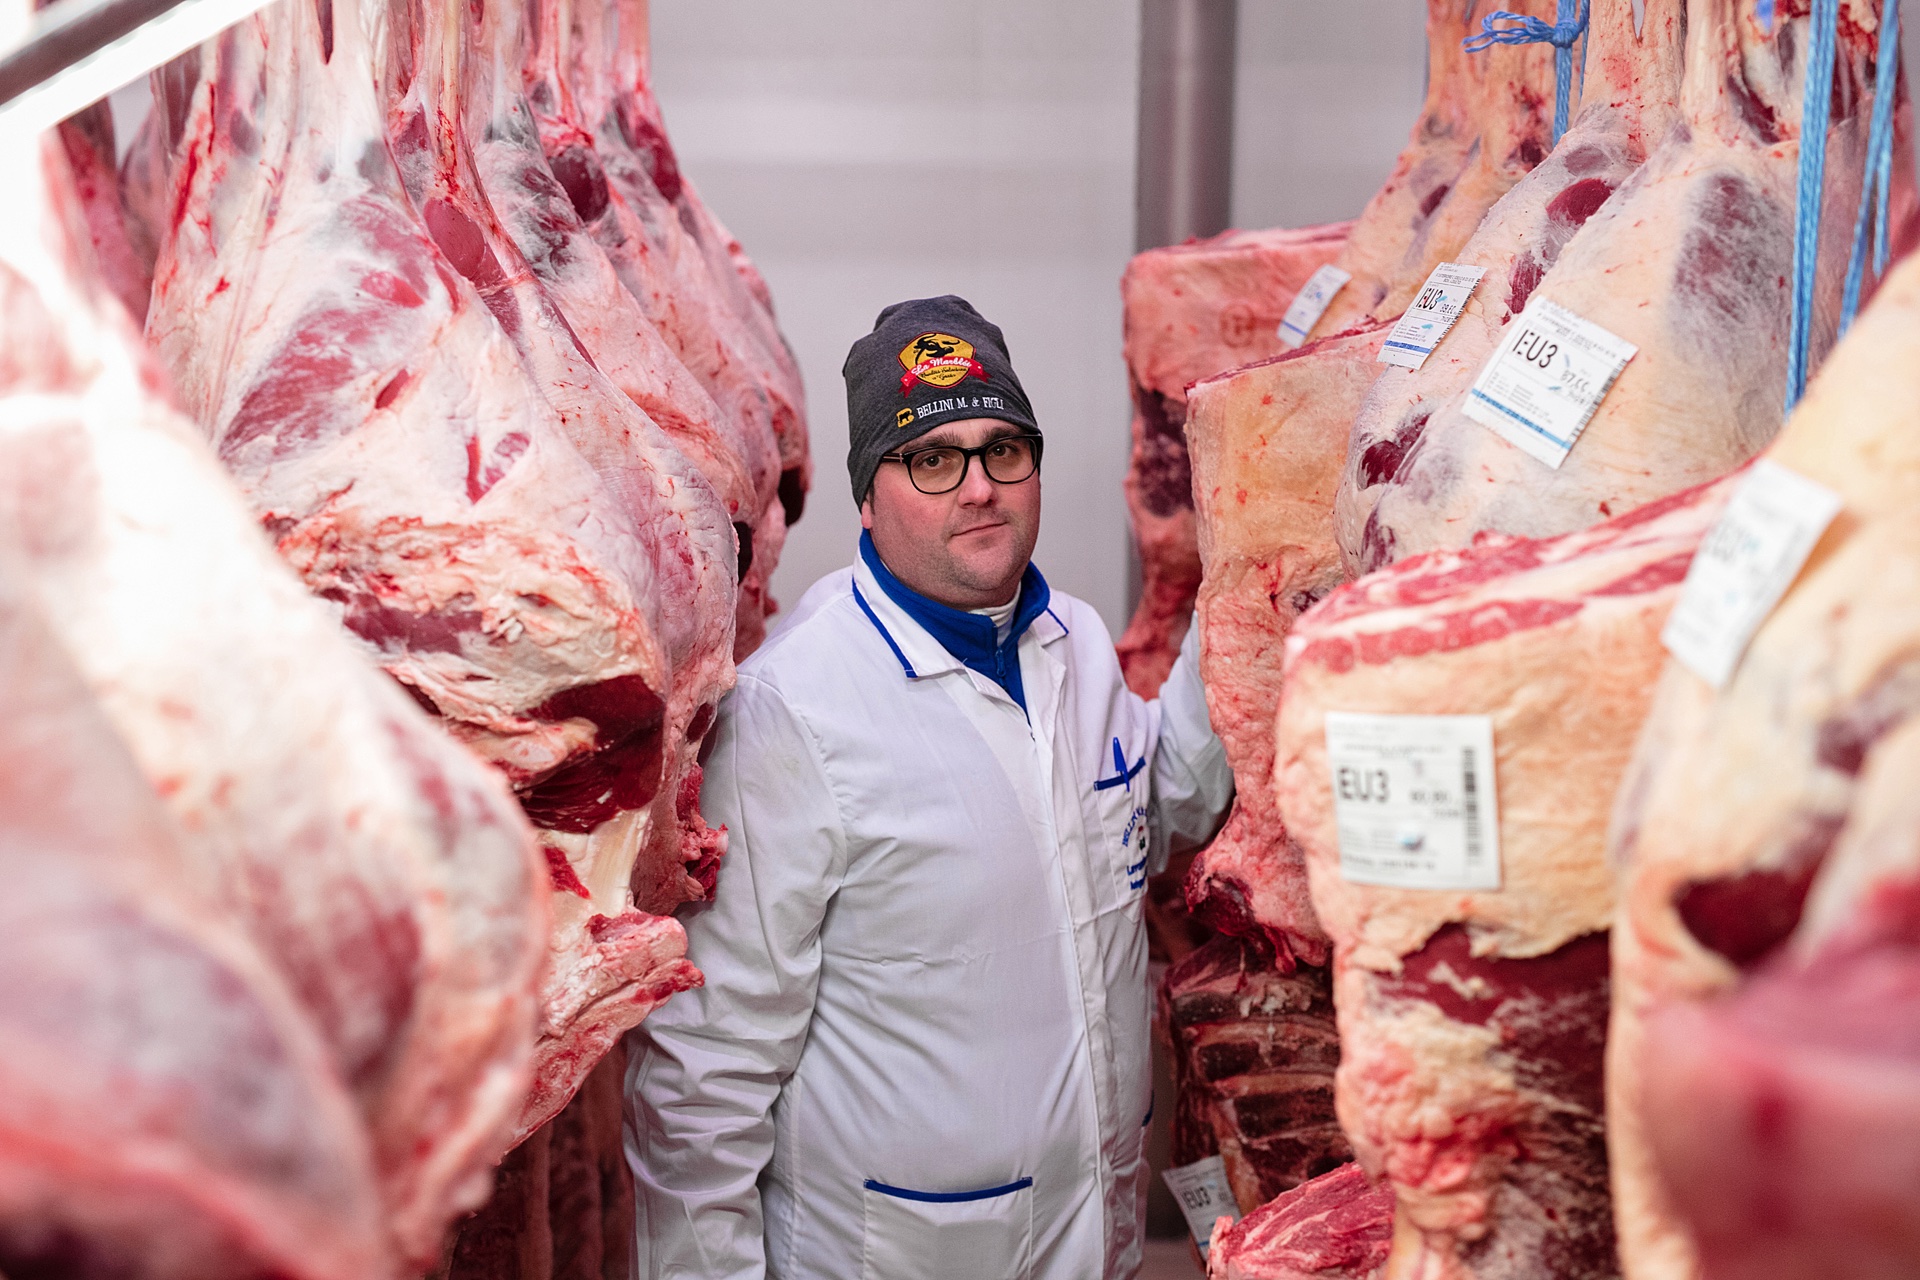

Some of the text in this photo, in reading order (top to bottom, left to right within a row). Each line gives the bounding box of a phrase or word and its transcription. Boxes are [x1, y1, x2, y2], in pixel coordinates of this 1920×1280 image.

[1416, 288, 1443, 310] EU3
[1513, 329, 1558, 368] EU3
[911, 362, 929, 376] La
[916, 397, 1004, 418] BELLINI M. & FIGLI
[1338, 768, 1389, 802] EU3
